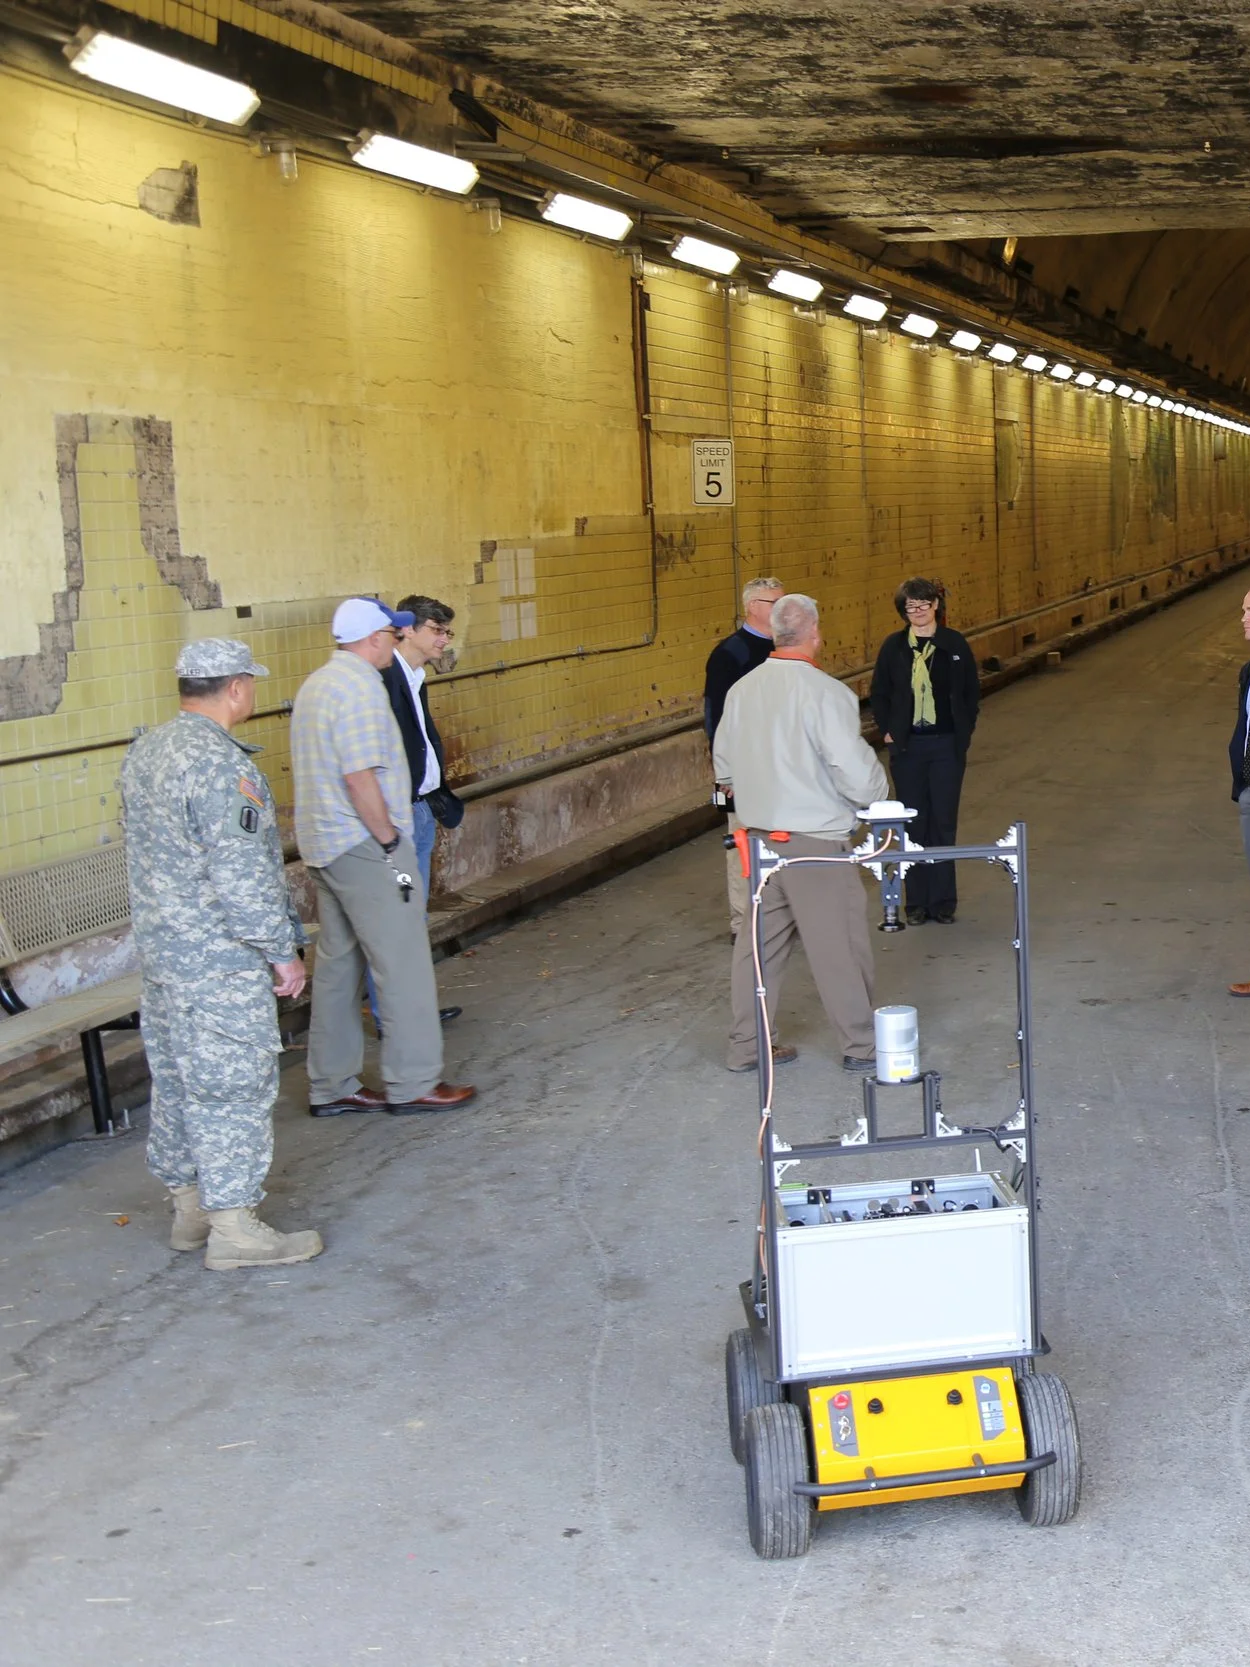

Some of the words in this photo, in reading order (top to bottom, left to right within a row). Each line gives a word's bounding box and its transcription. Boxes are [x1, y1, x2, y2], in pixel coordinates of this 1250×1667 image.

[695, 446, 730, 456] SPEED
[700, 458, 726, 468] LIMIT
[704, 471, 722, 498] 5
